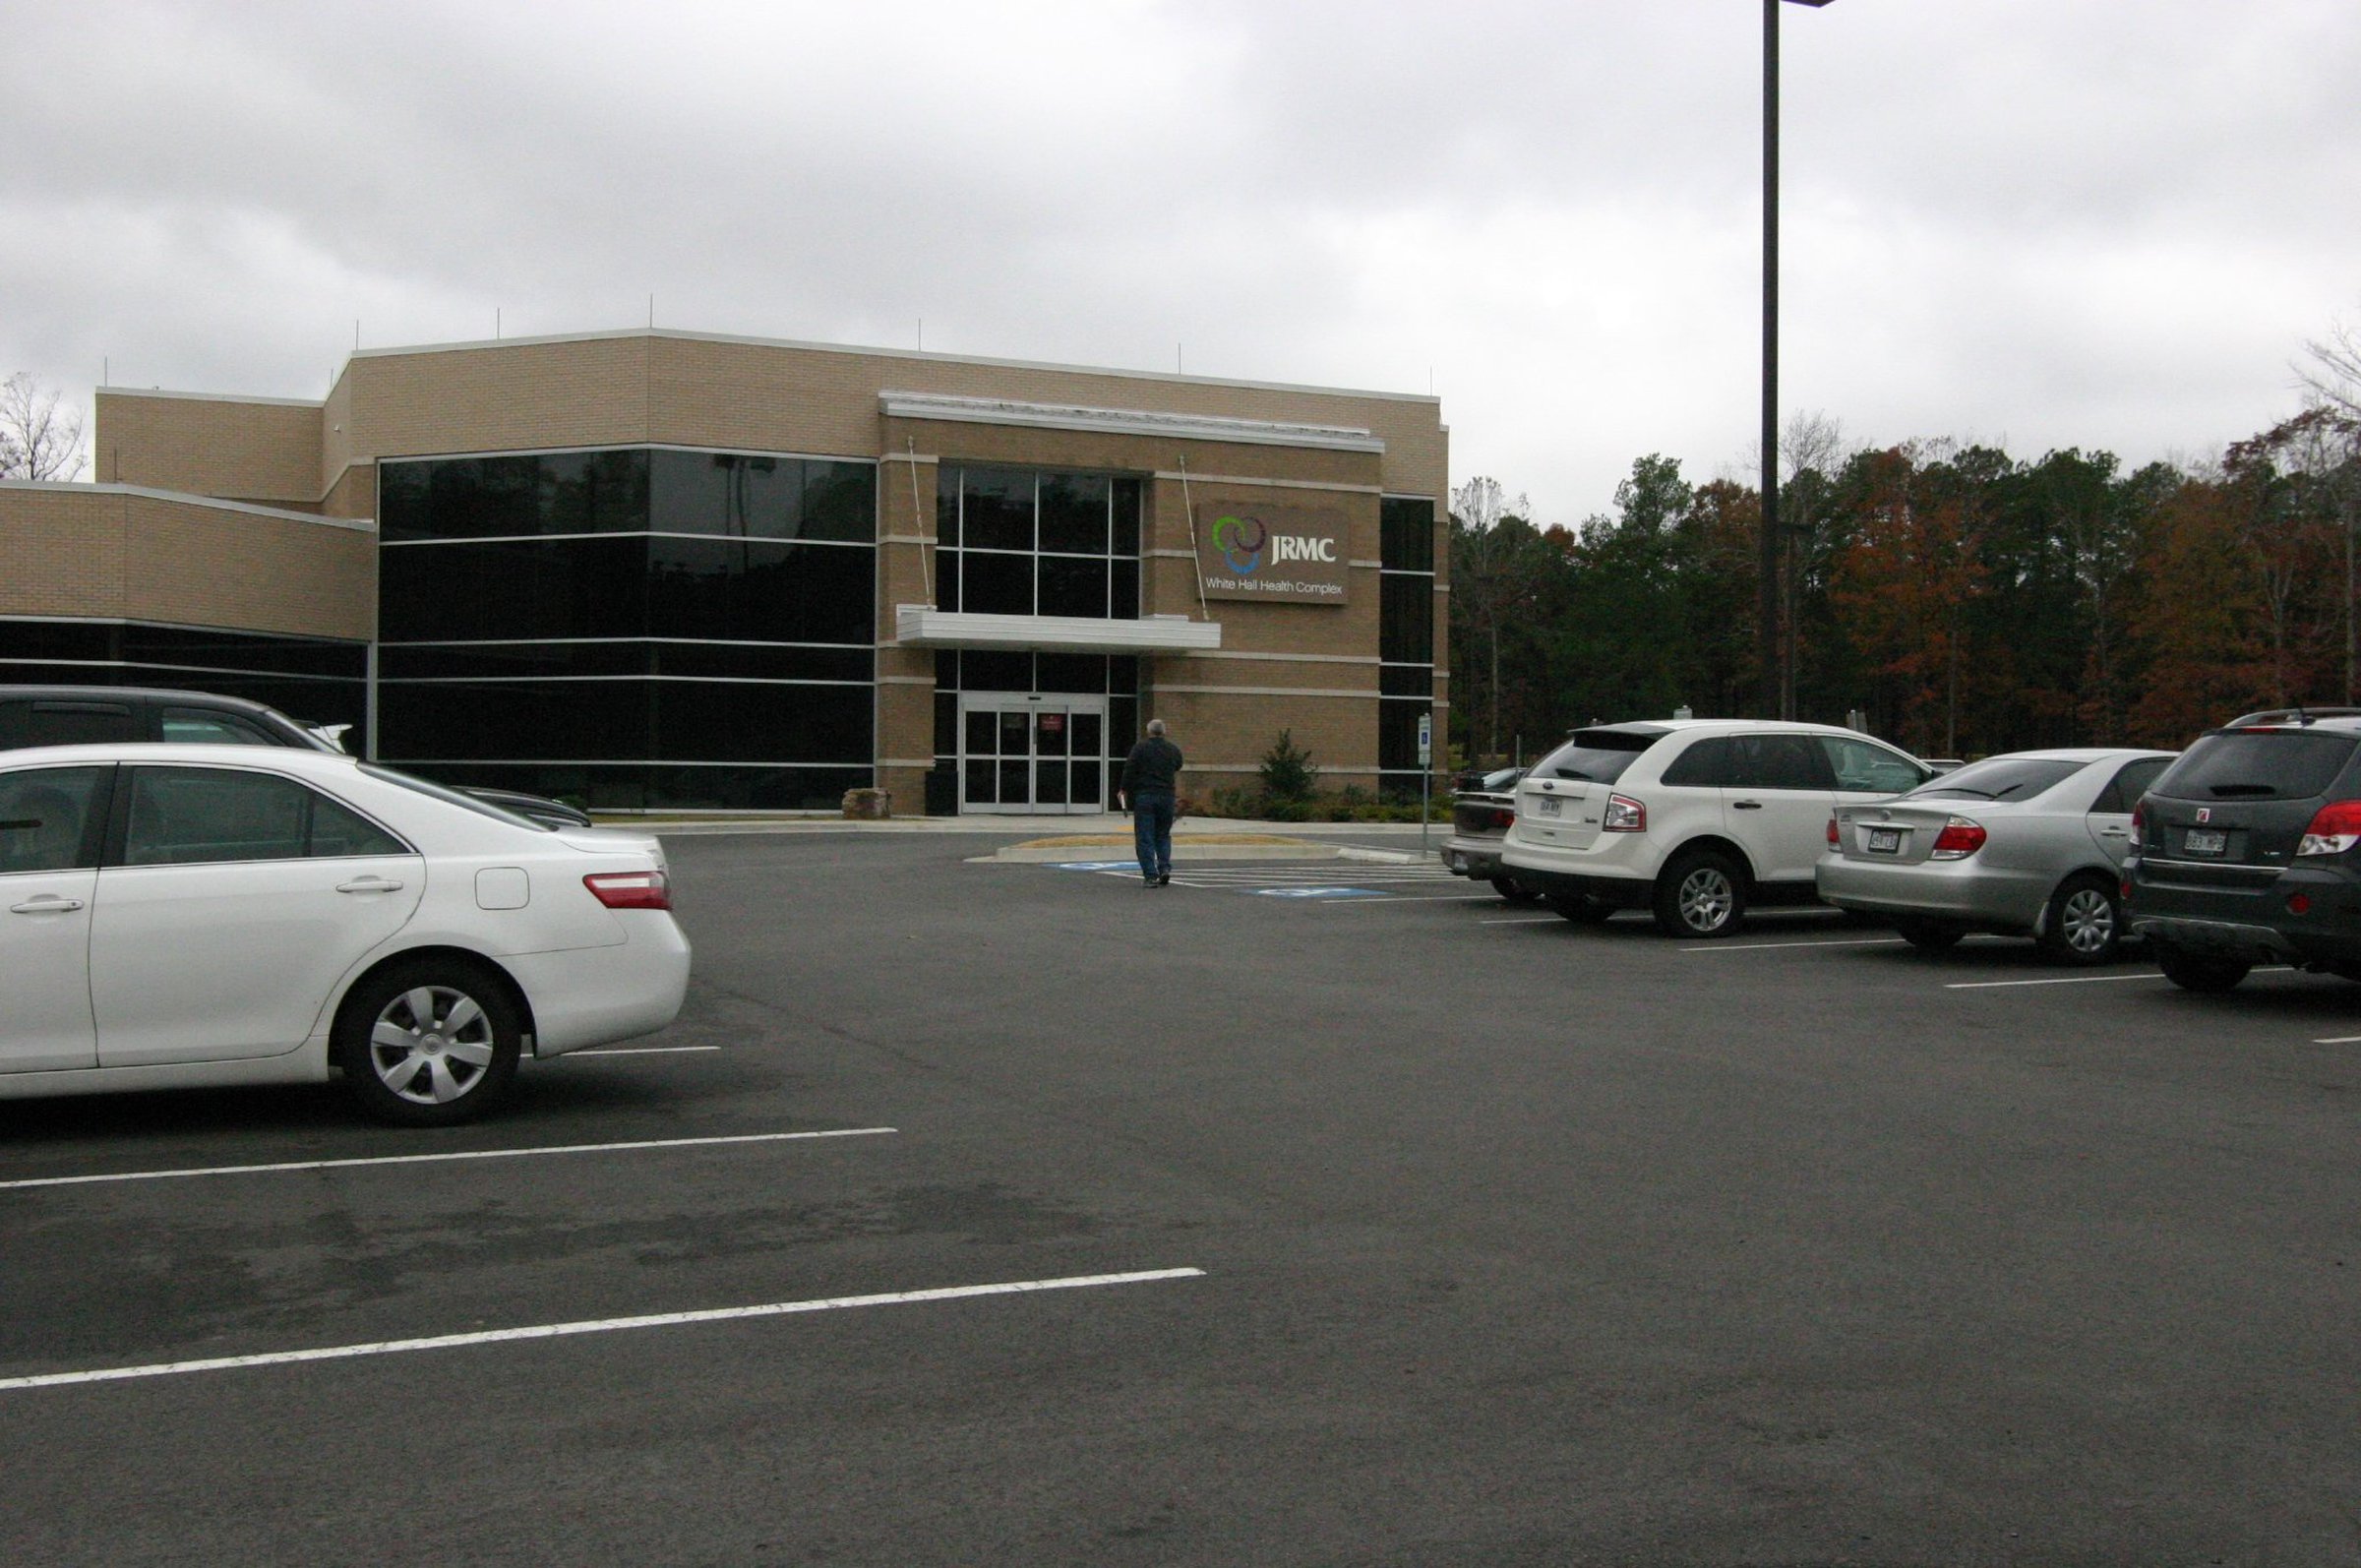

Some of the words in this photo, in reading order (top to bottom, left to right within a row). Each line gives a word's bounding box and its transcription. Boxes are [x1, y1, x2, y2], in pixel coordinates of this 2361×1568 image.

[1271, 535, 1336, 566] JRMC
[1205, 576, 1236, 589] White
[1238, 578, 1257, 590] Hall
[1260, 579, 1295, 592] Health
[1296, 581, 1343, 596] Complex
